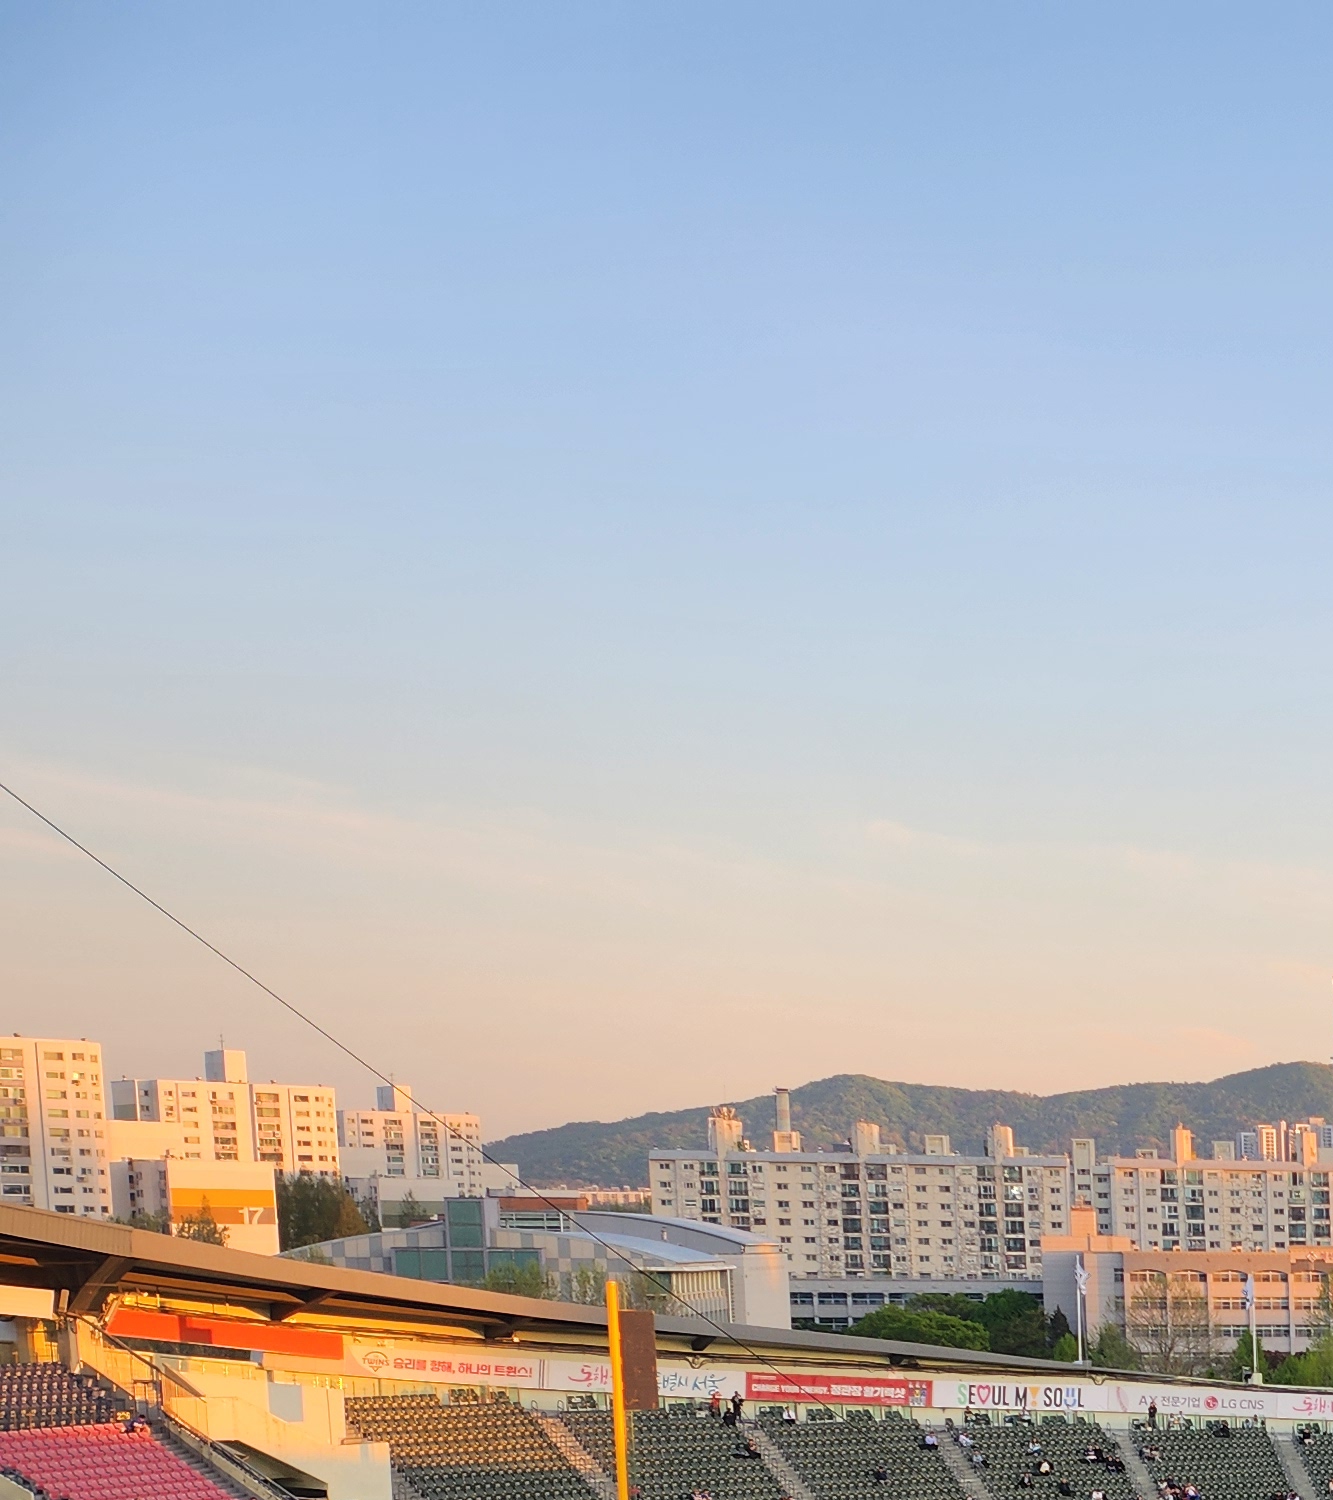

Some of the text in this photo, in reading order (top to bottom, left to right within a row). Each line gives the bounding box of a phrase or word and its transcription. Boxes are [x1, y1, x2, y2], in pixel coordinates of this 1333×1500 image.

[238, 1206, 264, 1225] 17
[362, 1357, 390, 1367] TWINS
[394, 1358, 532, 1379] 승리를 향해, 하나의 트윈스!
[1160, 1397, 1200, 1408] 전문기업
[1221, 1399, 1264, 1410] LG CNS
